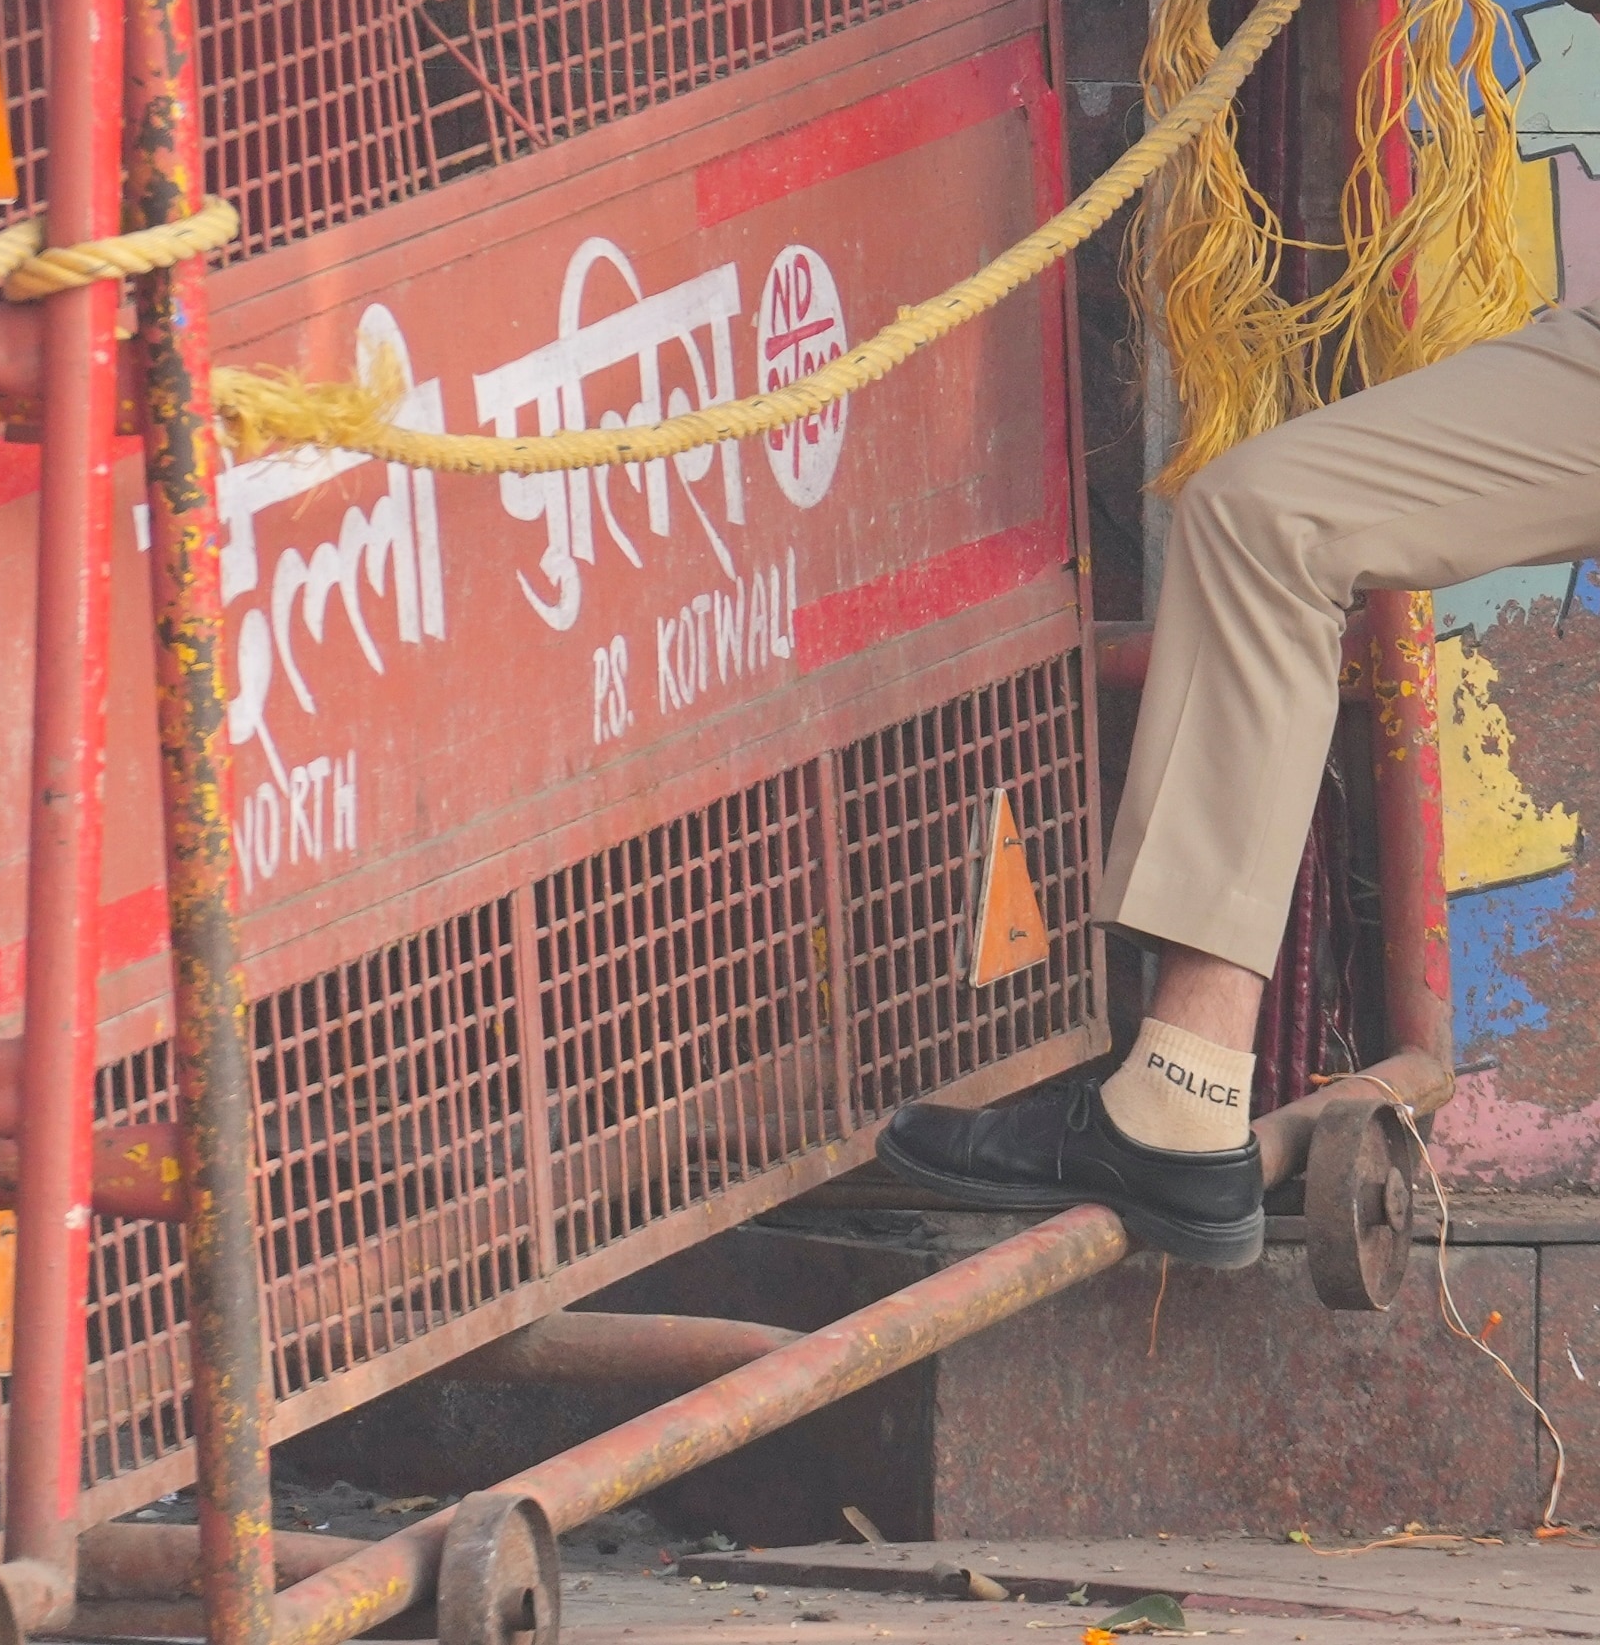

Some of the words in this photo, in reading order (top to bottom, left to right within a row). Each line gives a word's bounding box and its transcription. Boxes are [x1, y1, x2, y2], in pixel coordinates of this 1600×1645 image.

[771, 253, 813, 336] ND
[473, 237, 744, 631] पुलिस
[656, 549, 797, 713] KOTWALI
[1147, 1052, 1241, 1107] POLICE
